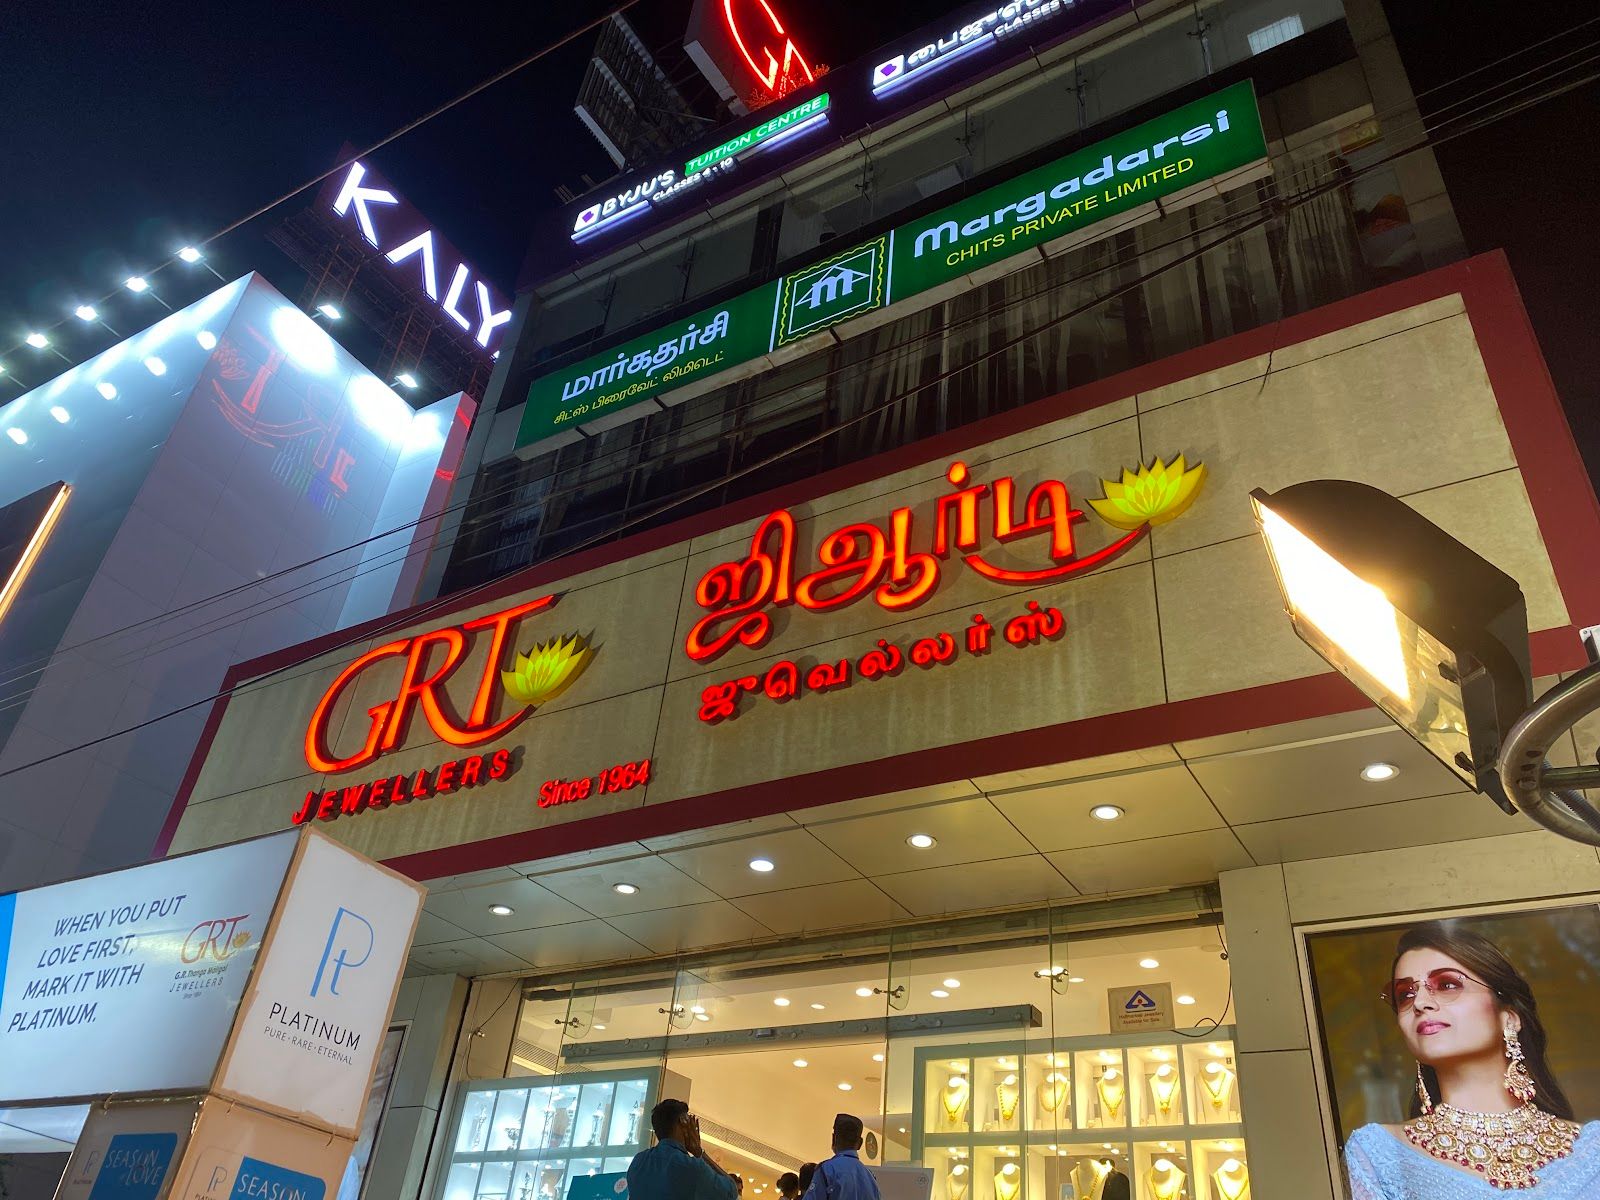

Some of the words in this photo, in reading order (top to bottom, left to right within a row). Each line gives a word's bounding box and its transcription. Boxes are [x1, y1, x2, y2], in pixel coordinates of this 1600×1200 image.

[994, 0, 1060, 38] CLASSES
[689, 134, 751, 171] TUITION
[756, 98, 822, 138] CENTRE
[602, 169, 675, 216] BYJU'S
[652, 172, 701, 202] CLASSES
[914, 109, 1231, 257] Margadarsi
[946, 234, 1006, 266] CHITS
[1011, 195, 1099, 241] PRIVATE
[1104, 157, 1194, 203] LIMITED
[332, 160, 512, 360] KALY
[561, 310, 730, 402] மார்கதர்சி
[304, 594, 556, 775] GRT
[291, 748, 514, 825] JEWELLERS
[537, 776, 591, 808] Since
[598, 758, 651, 795] 1964
[54, 911, 106, 938] WHEN
[108, 903, 146, 928] YOU
[146, 894, 187, 920] PUT
[181, 913, 250, 964] GRT
[37, 943, 83, 969] LOVE
[22, 974, 74, 1001] MARK
[72, 971, 95, 993] IT
[95, 963, 145, 990] WITH
[169, 976, 224, 993] JEWELLERS
[7, 1002, 99, 1033] PLATINUM.
[269, 1002, 361, 1051] PLATINUM
[263, 1026, 287, 1042] PURE
[291, 1036, 313, 1051] RARE
[317, 1045, 353, 1066] ETERNAL
